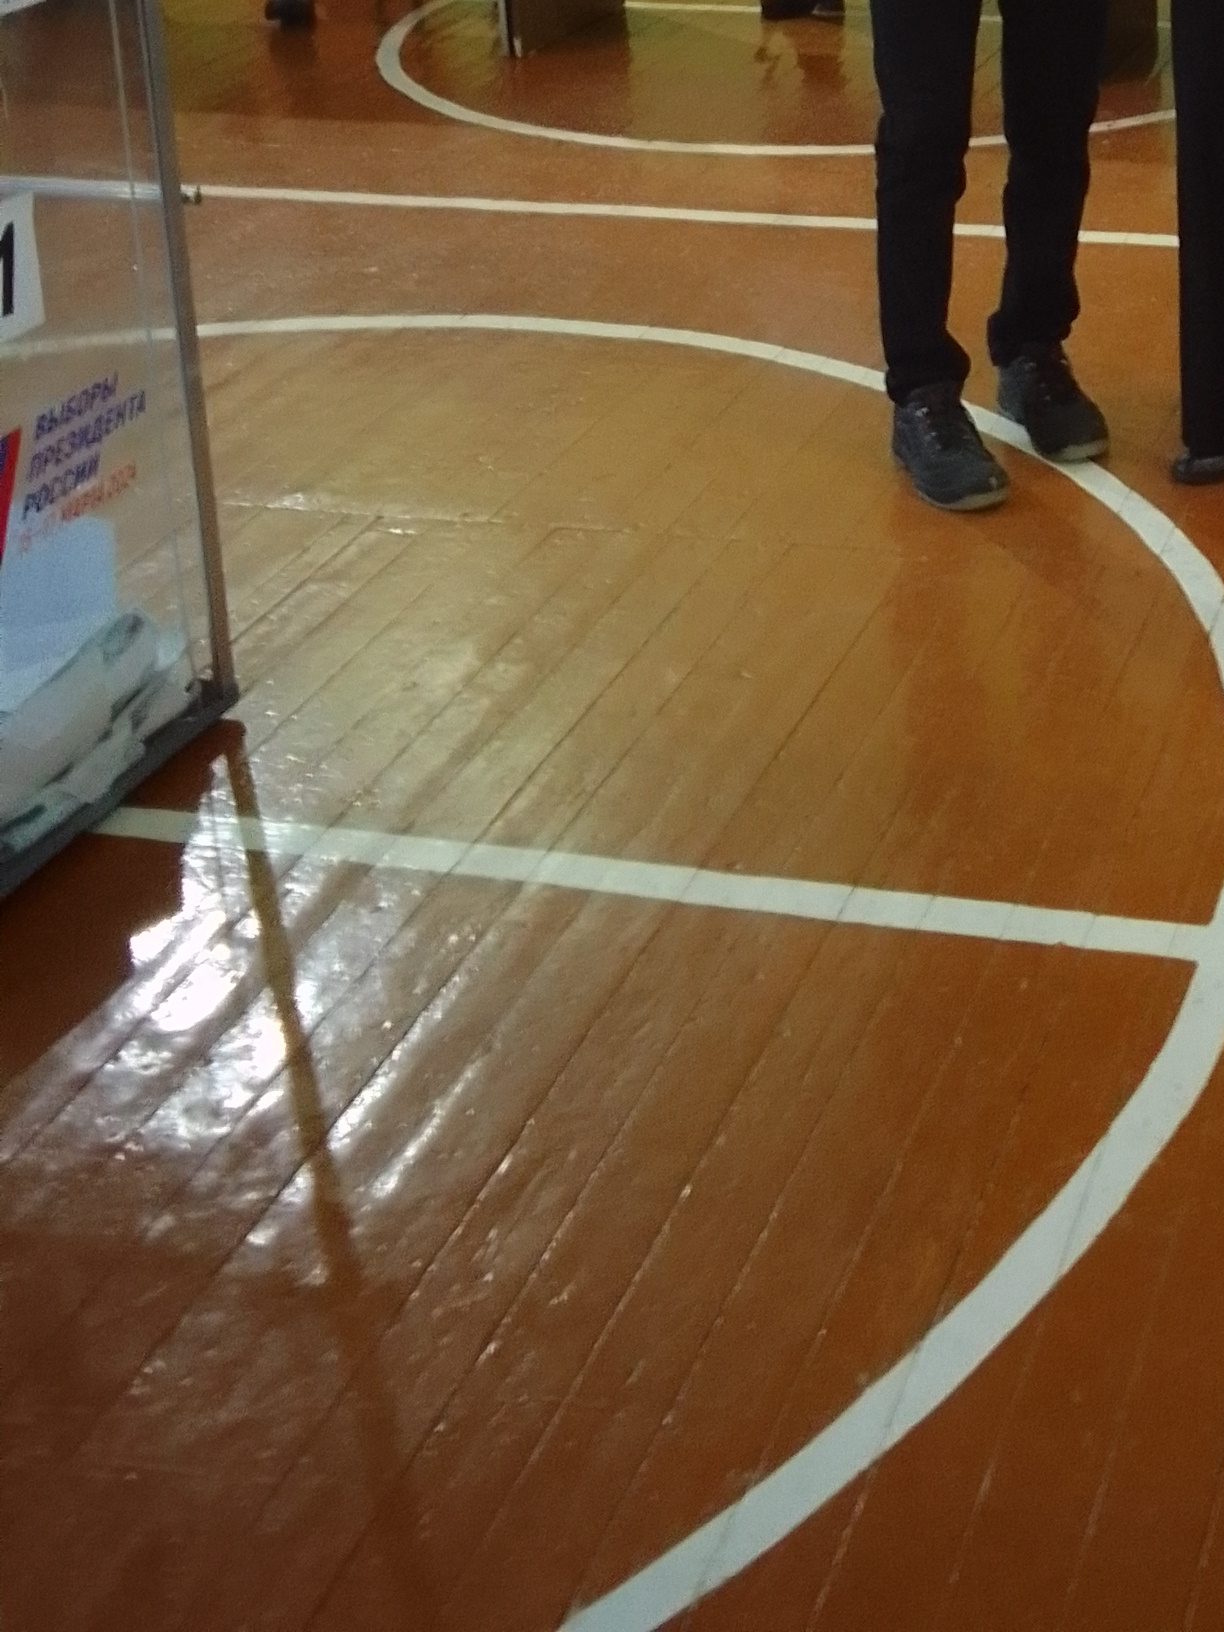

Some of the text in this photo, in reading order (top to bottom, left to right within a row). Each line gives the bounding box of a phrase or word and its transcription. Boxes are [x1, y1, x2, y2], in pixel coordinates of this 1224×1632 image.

[27, 390, 146, 483] ПРЕЗИДЕНТА
[34, 371, 118, 440] ВЫБОРЫ
[22, 450, 100, 520] РОССИИ
